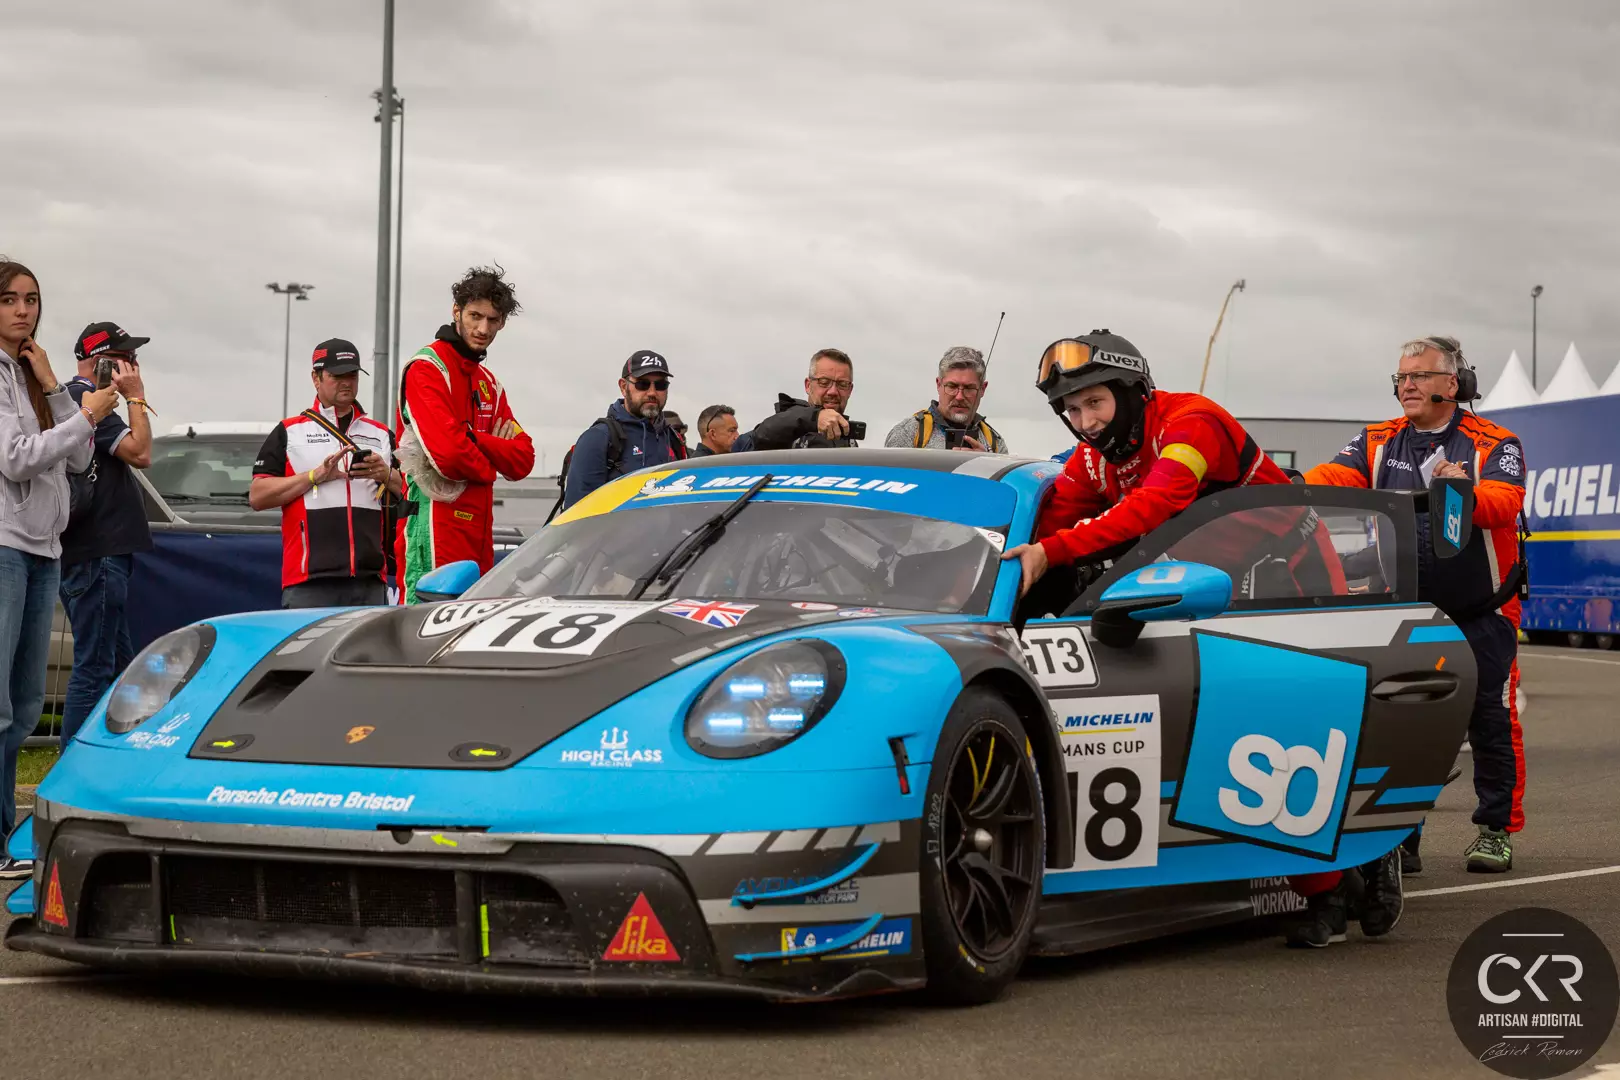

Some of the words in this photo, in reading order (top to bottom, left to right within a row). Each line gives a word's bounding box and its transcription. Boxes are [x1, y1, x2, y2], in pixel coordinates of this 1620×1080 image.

[1100, 352, 1142, 368] uvex
[700, 475, 919, 495] MICHELIN
[1517, 464, 1620, 519] ICHEL
[488, 611, 616, 649] 18
[1021, 637, 1085, 675] GT3
[1065, 711, 1154, 727] MICHELIN
[561, 750, 605, 762] HIGH
[609, 749, 662, 762] CLASS
[1112, 740, 1145, 754] CUP
[1218, 727, 1348, 837] sd
[206, 785, 279, 805] Porsche
[278, 788, 344, 808] Centre
[343, 791, 416, 812] Bristol
[611, 915, 668, 955] Sika
